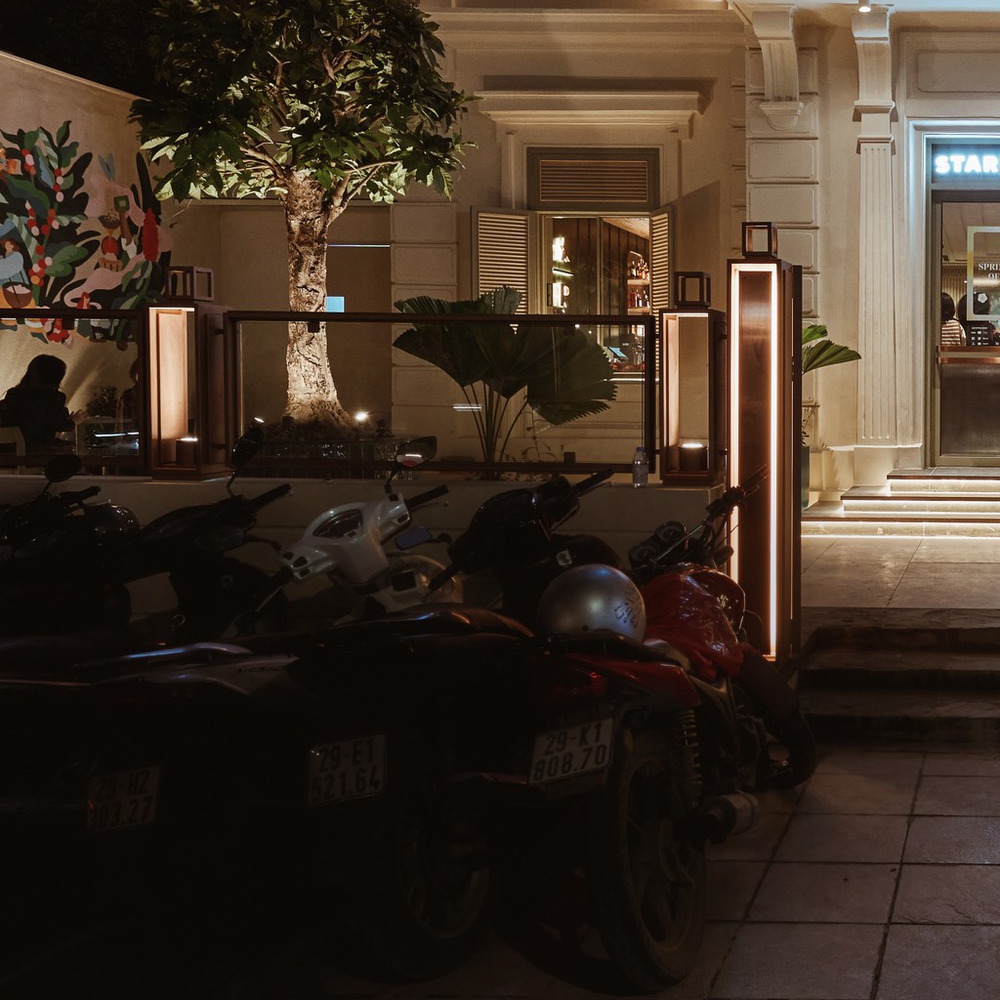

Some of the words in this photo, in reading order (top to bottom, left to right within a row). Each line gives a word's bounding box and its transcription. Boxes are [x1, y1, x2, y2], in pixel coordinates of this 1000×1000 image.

[988, 272, 1000, 280] OF
[318, 738, 375, 773] 29-E1
[545, 722, 602, 755] 29-K1
[534, 744, 607, 781] 808.70
[311, 764, 380, 803] 521.64
